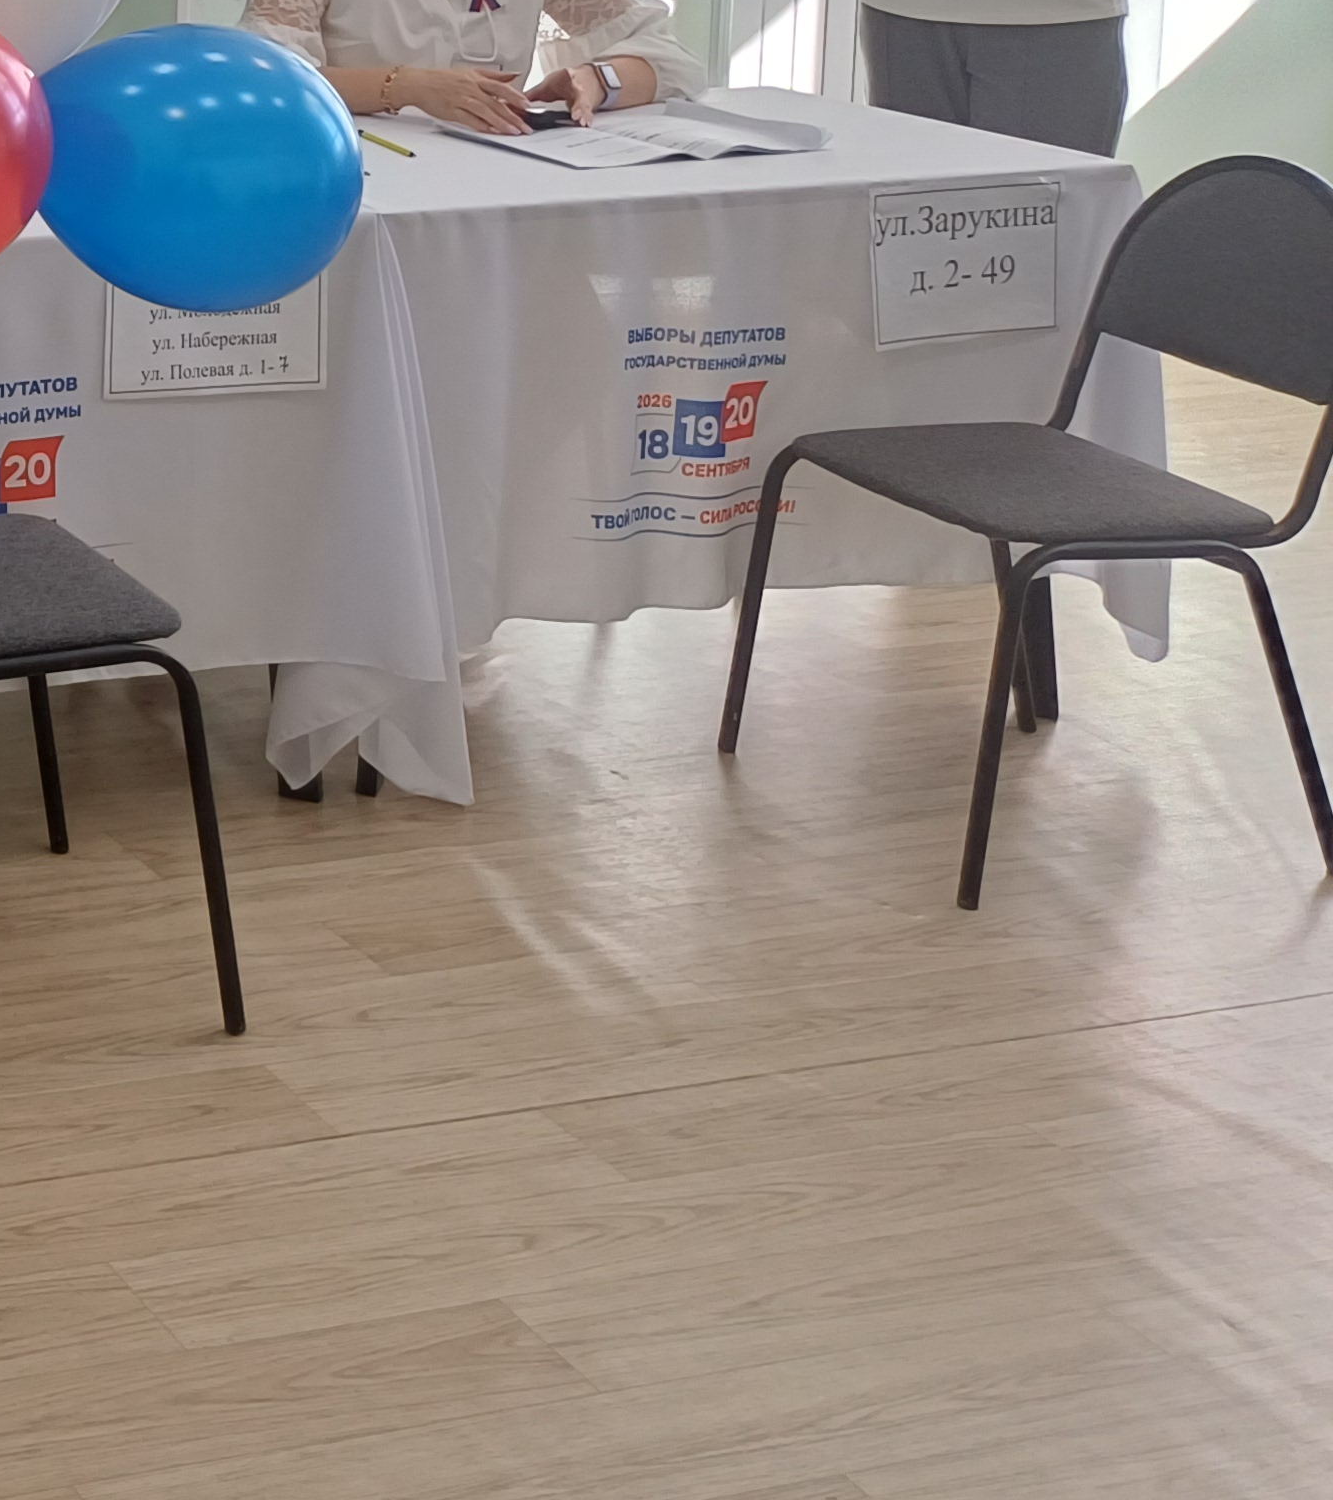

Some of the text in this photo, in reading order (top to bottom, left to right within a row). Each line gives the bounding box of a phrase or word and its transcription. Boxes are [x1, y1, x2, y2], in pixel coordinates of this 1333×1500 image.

[909, 270, 934, 297] д.
[149, 308, 172, 324] ул.
[152, 332, 277, 354] ул. Набережная
[628, 327, 786, 348] ВЫБОРЫ ДЕПУТАТОВ
[624, 354, 786, 371] ГОСУДАРСТВЕННОЙ ДУМЫ
[140, 369, 164, 385] ул.
[170, 364, 234, 380] Полевая
[239, 364, 253, 377] д.
[636, 394, 672, 409] 2026
[724, 395, 755, 430] 20
[34, 405, 82, 423] ДУМЫ
[680, 414, 719, 447] 19
[638, 429, 669, 460] 18
[4, 452, 51, 489] 20
[681, 456, 750, 478] СЕНТЯБРЯ
[591, 509, 630, 530] ТВОЙ
[631, 506, 676, 522] ГОЛОС
[700, 507, 734, 525] СИЛА
